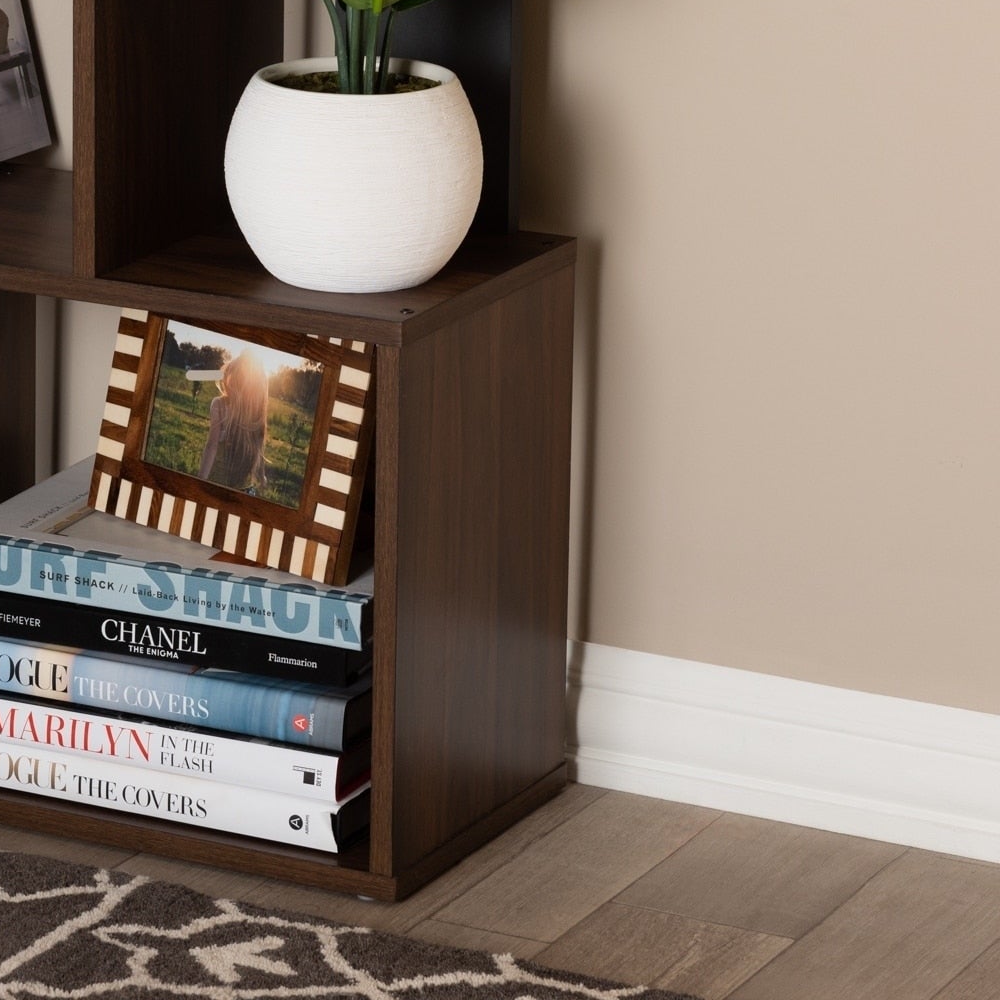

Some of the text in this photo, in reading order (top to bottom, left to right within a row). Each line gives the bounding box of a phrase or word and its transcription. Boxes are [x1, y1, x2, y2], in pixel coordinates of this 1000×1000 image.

[39, 570, 70, 583] SURF
[74, 576, 115, 591] SHACK
[132, 586, 179, 602] Laid-Back
[183, 594, 212, 609] Living
[215, 600, 227, 612] by
[230, 603, 245, 613] the
[248, 606, 276, 618] Water
[137, 561, 373, 644] SHACK
[101, 618, 207, 655] CHANEL
[128, 644, 179, 660] THE ENIGMA
[268, 652, 318, 669] Flammarion
[74, 675, 122, 703] THE
[123, 685, 209, 720] COVERS
[160, 734, 215, 757] IN THE
[160, 751, 213, 774] FLASH
[72, 774, 117, 802] THE
[122, 785, 208, 818] COVERS
